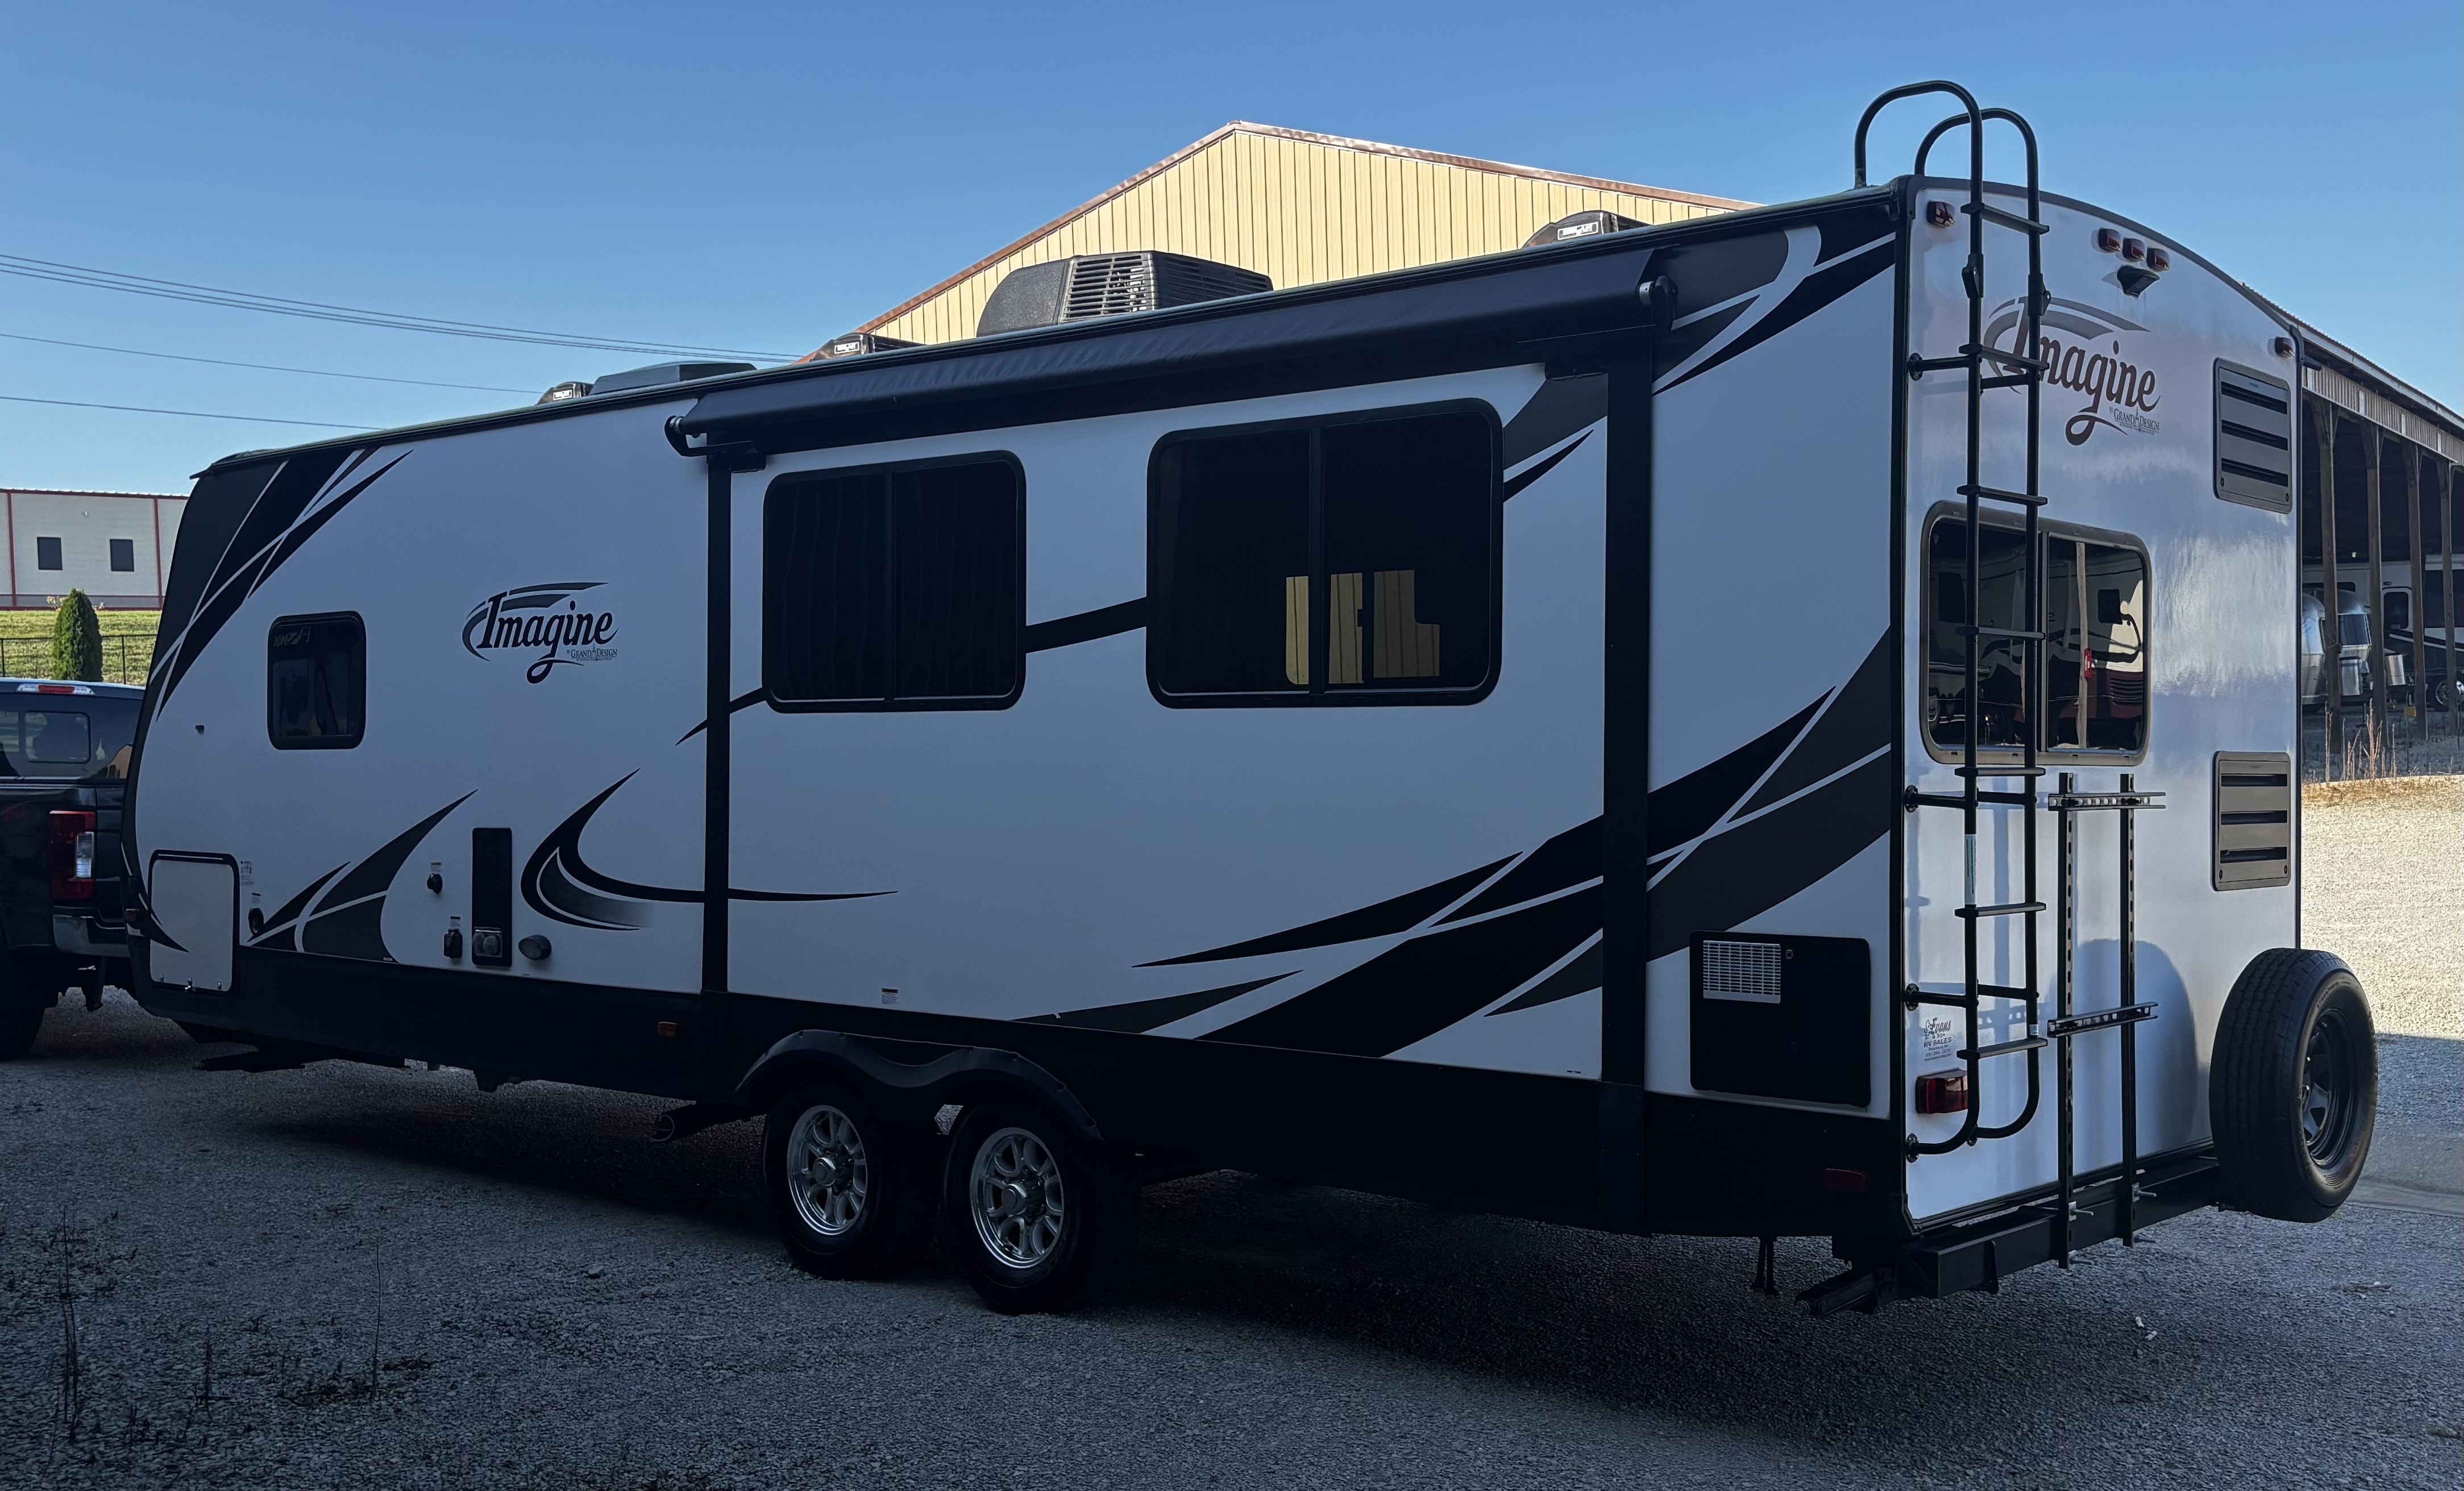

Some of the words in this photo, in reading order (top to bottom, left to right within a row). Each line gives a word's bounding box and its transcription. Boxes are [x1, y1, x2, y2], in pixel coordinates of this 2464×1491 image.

[2114, 409, 2135, 426] GRAND
[2139, 415, 2160, 431] DESIGN
[476, 591, 619, 684] Imagine
[571, 649, 592, 659] GRAND
[597, 648, 618, 657] DESIGN
[1933, 1037, 1952, 1046] SALES
